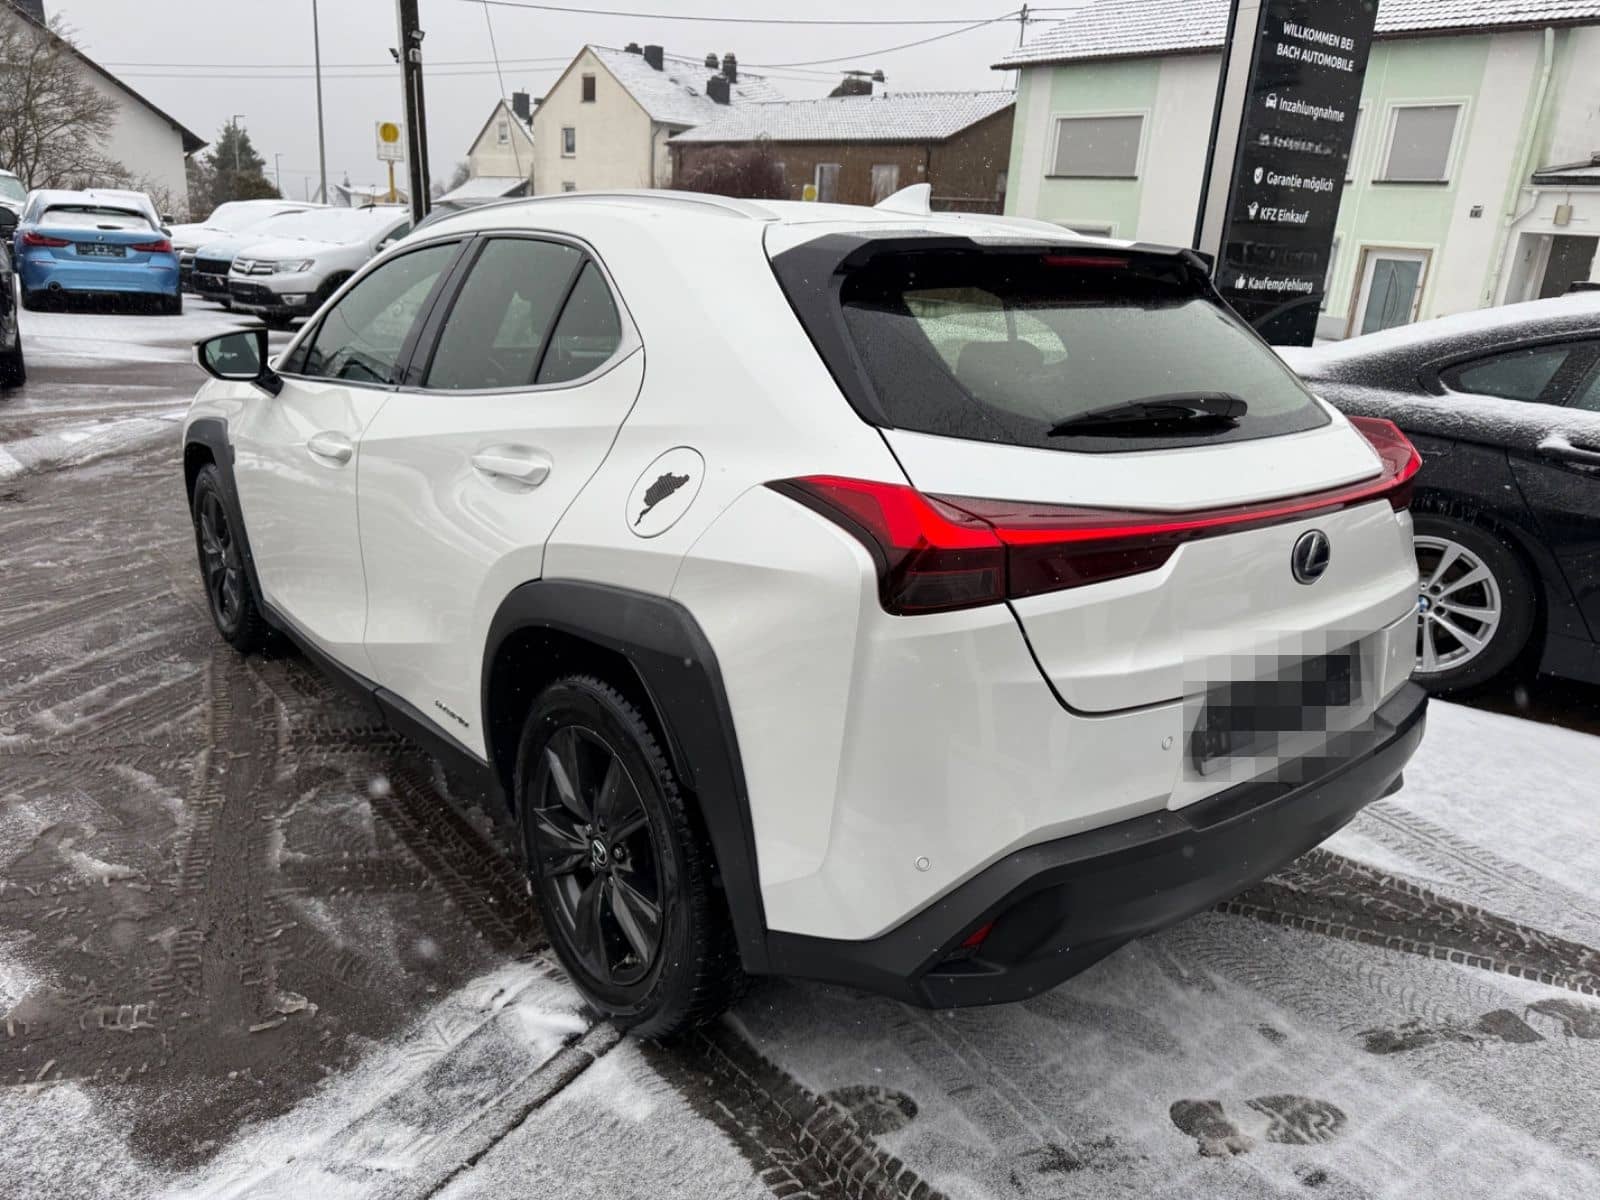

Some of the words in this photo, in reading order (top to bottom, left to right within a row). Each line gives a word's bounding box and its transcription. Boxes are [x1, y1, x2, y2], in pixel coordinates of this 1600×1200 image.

[1283, 22, 1340, 48] WILLKOMMEN
[1340, 37, 1355, 51] BEI
[1276, 43, 1300, 59] BACH
[1301, 50, 1355, 72] AUTOMOBILE
[1279, 98, 1345, 122] Inzahlungnahme
[1266, 171, 1302, 188] Garantie
[1303, 177, 1334, 193] möglich
[1260, 207, 1278, 221] KFZ
[1278, 209, 1309, 224] Einkauf
[1248, 276, 1313, 294] Kaufempfehlung
